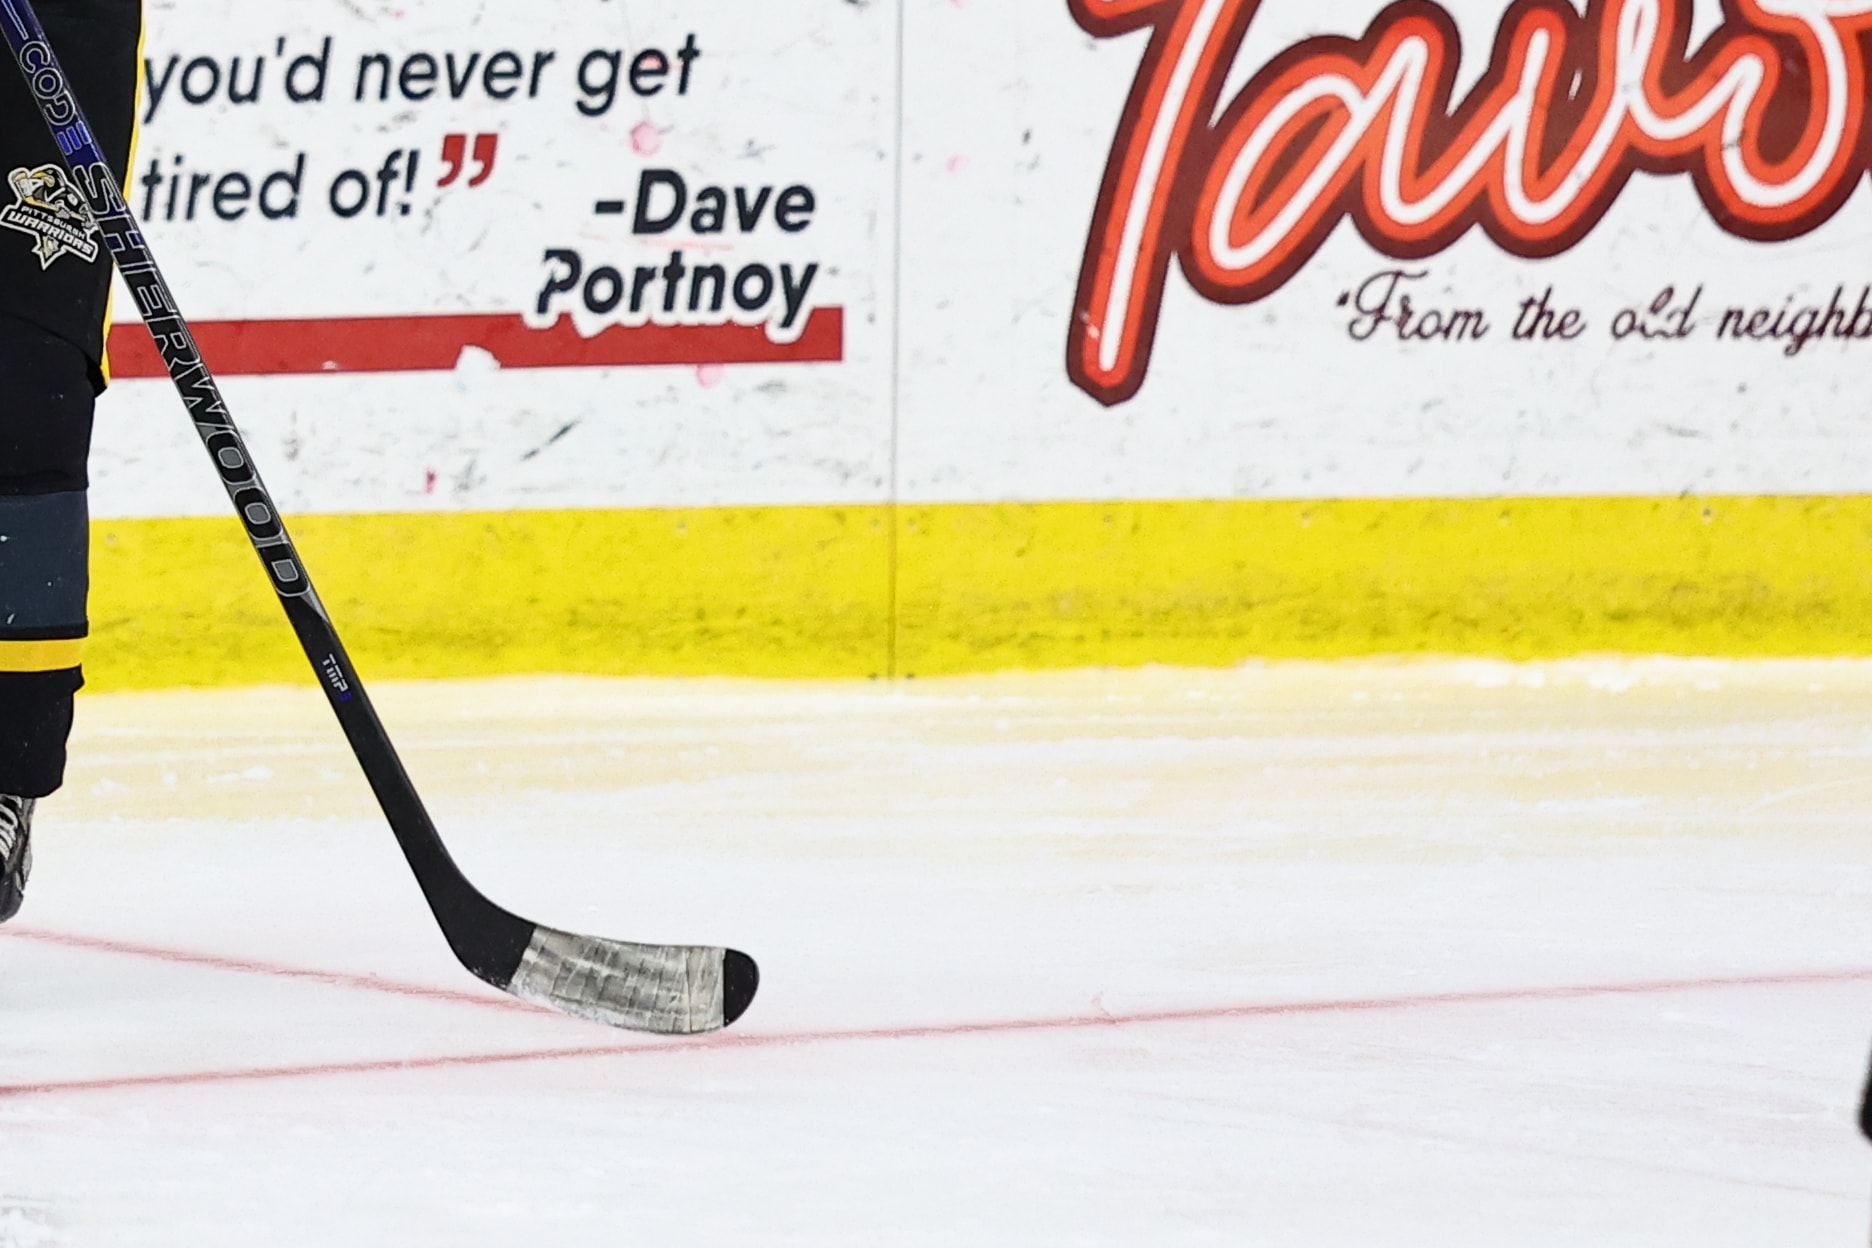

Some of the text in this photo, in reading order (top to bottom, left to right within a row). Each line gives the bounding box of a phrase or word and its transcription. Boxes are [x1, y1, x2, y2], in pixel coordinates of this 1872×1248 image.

[142, 32, 701, 125] you'd never get
[140, 151, 306, 223] tired
[593, 168, 816, 236] -Dave
[6, 210, 95, 255] WARRIORS
[535, 247, 820, 330] Portnoy
[1510, 283, 1586, 341] the
[72, 161, 312, 598] SHERWOOD
